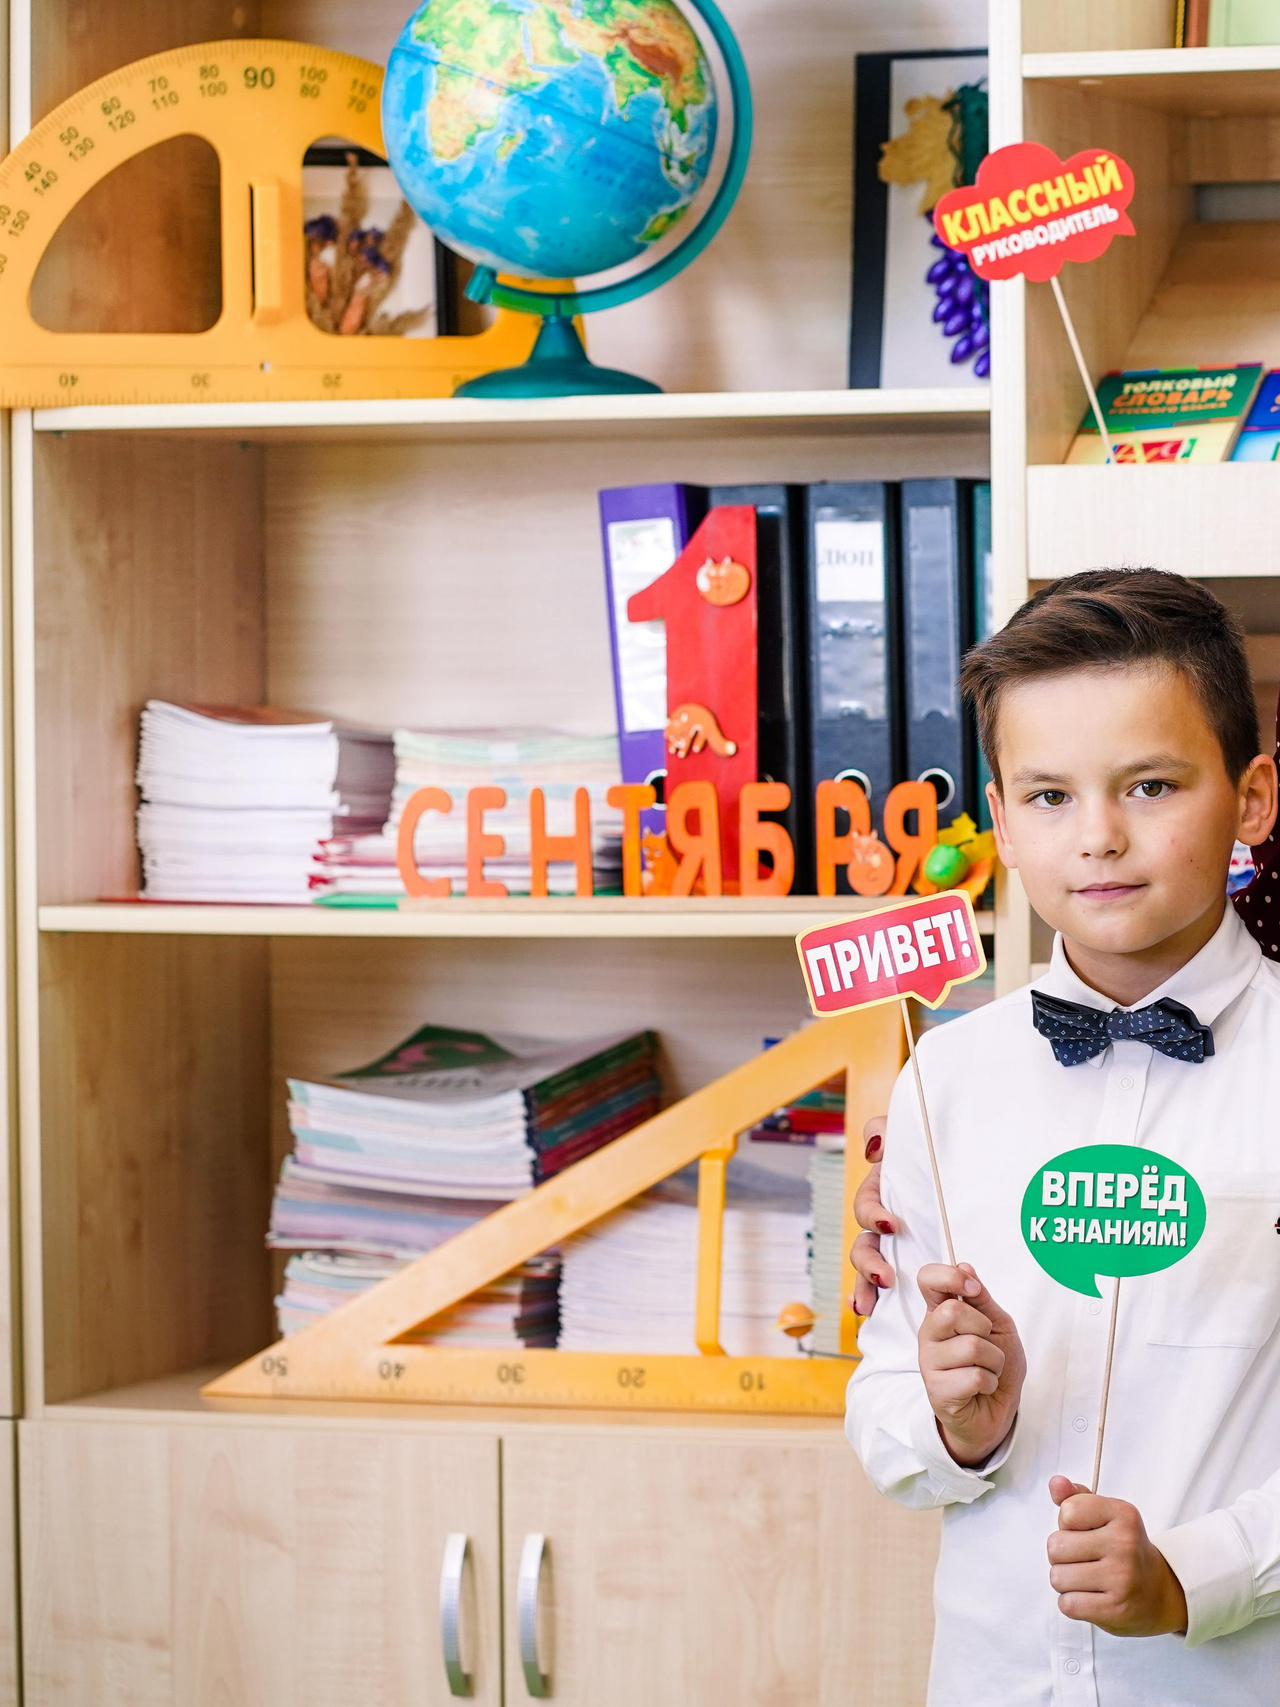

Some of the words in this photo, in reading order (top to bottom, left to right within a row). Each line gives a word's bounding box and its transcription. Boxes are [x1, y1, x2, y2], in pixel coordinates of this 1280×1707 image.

[24, 161, 42, 182] 40
[59, 126, 79, 147] 50
[101, 96, 121, 116] 60
[148, 75, 168, 94] 70
[200, 64, 219, 80] 80
[243, 66, 275, 89] 90
[300, 65, 328, 83] 100
[351, 78, 377, 99] 110
[8, 209, 30, 238] 150
[34, 170, 58, 196] 140
[69, 136, 94, 161] 130
[108, 109, 136, 133] 120
[152, 91, 179, 111] 110
[200, 81, 228, 98] 100
[300, 83, 320, 100] 80
[348, 97, 367, 115] 70
[941, 154, 1124, 246] КЛАССНЫЙ
[971, 203, 1119, 266] РУКОВОДИТЕЛЬ
[59, 373, 79, 388] 40
[191, 373, 210, 388] 30
[323, 373, 342, 388] 20
[1122, 373, 1238, 395] ТОЛКОВЫЙ
[1112, 388, 1233, 407] СЛОВАРЬ
[627, 504, 758, 888] 1
[397, 780, 938, 898] СЕНТЯБРЯ
[805, 908, 971, 997] ПРИВЕТ!
[1041, 1164, 1188, 1217] ВПЕРЁД
[1029, 1216, 1048, 1242] К
[1052, 1217, 1187, 1247] ЗНАНИЯМ!
[261, 1357, 288, 1378] 50
[378, 1360, 405, 1380] 40
[497, 1364, 525, 1384] 30
[618, 1368, 646, 1388] 20
[739, 1371, 765, 1391] 10
